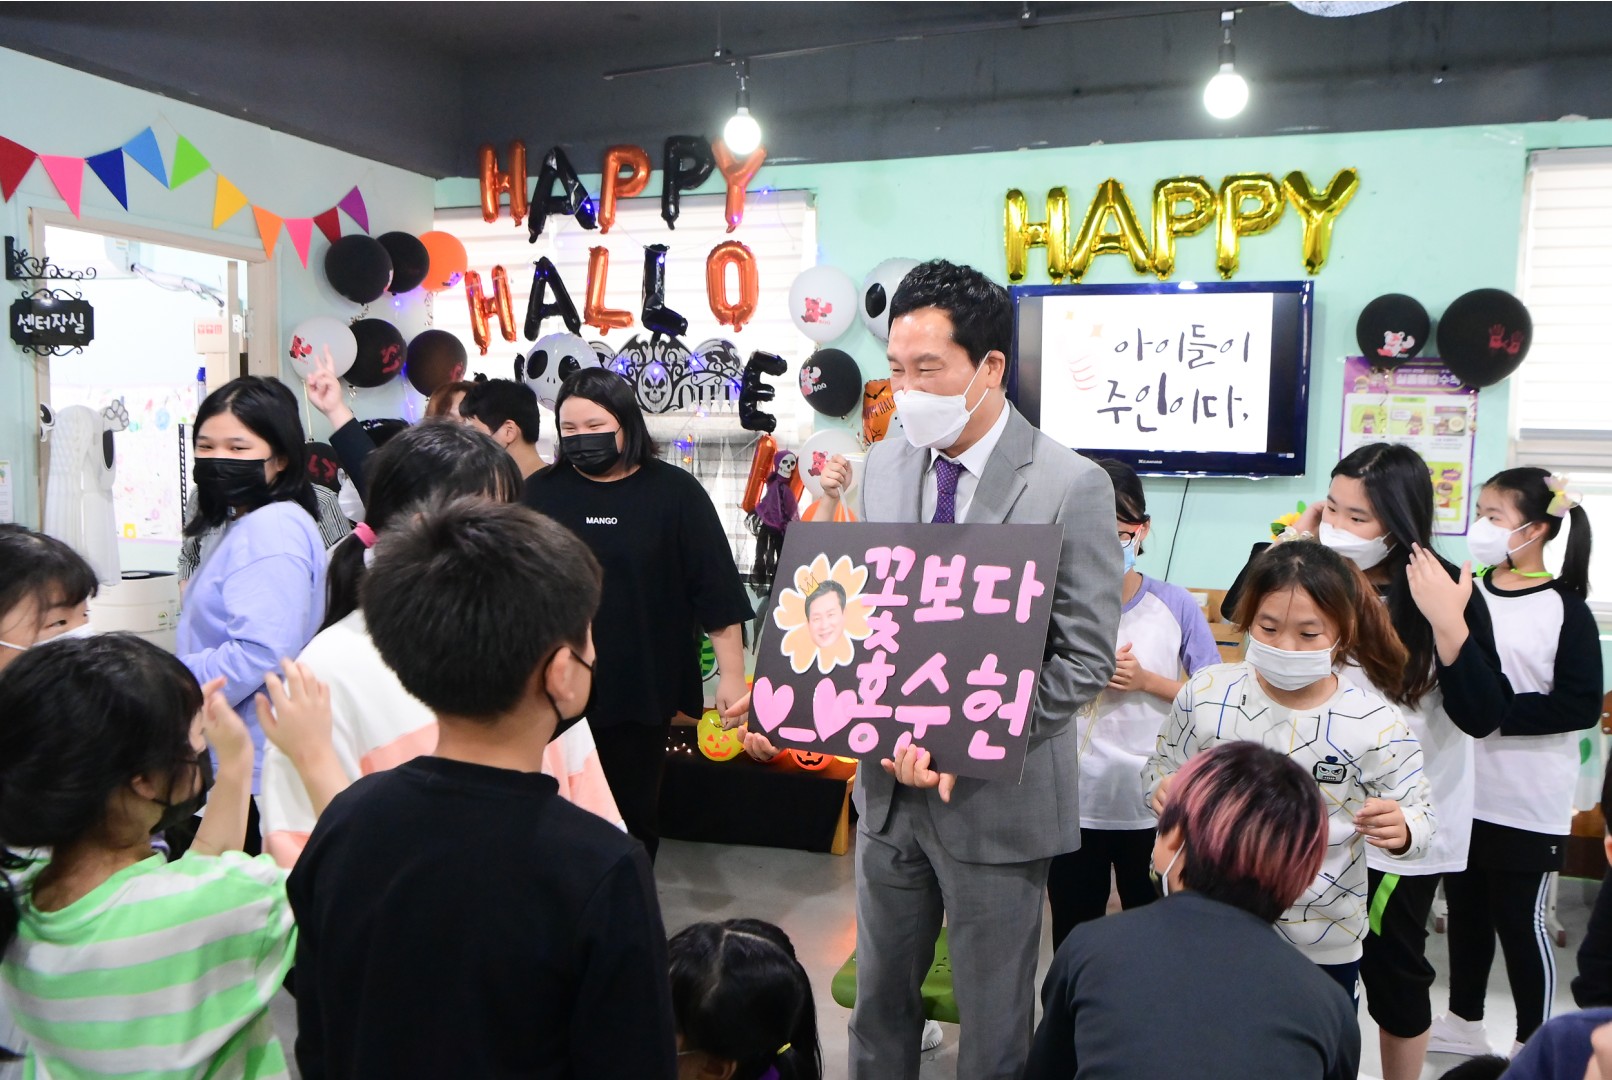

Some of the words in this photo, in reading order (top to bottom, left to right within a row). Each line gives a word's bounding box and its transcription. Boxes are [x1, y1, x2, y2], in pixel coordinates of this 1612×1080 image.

[479, 136, 767, 243] HAPPY
[1004, 167, 1360, 285] HAPPY
[17, 312, 85, 334] 센터장실
[465, 240, 759, 355] HALLO
[1115, 324, 1250, 370] 아이들이
[585, 516, 618, 525] MANGO
[861, 545, 1045, 654] 꽃보다
